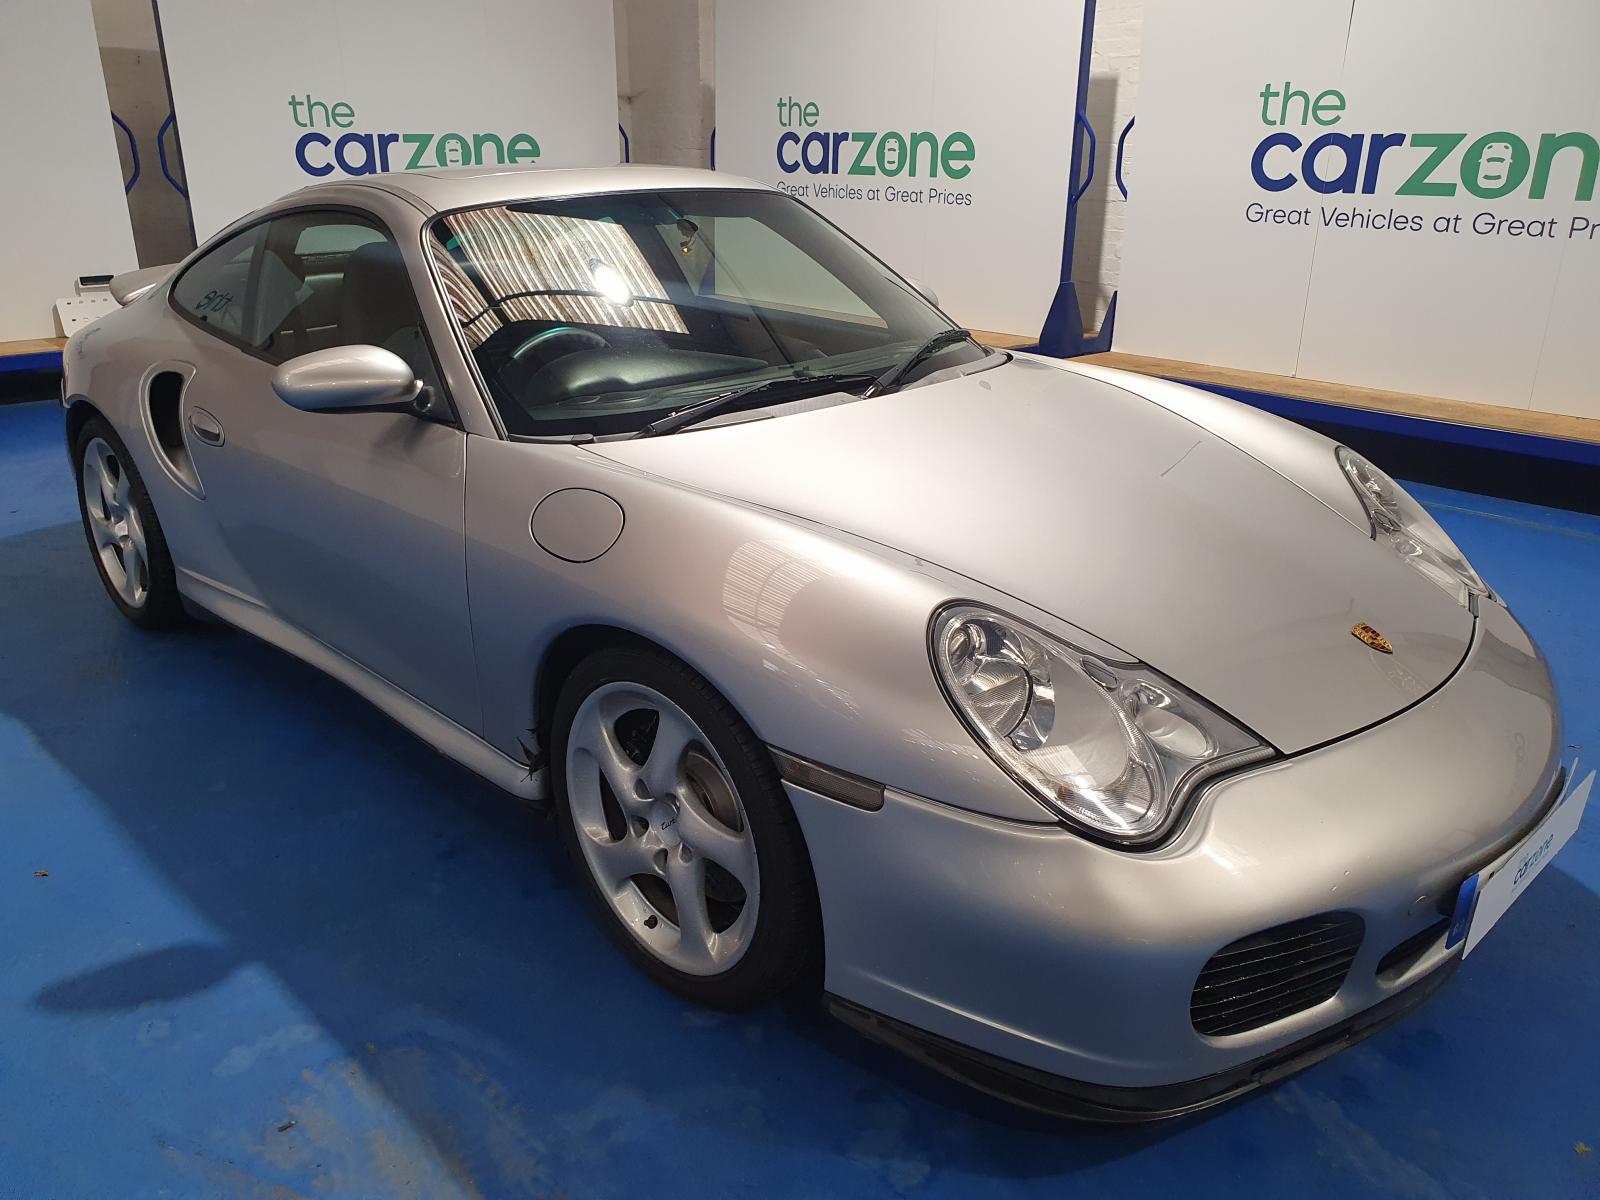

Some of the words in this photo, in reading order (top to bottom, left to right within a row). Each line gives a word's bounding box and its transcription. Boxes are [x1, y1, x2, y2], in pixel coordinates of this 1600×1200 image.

[288, 95, 355, 128] the
[777, 96, 820, 127] the
[1260, 82, 1346, 126] the
[295, 132, 541, 177] carzone
[777, 131, 976, 180] carzone
[813, 184, 863, 201] Vehicles
[867, 188, 880, 201] at
[884, 186, 923, 204] Great
[928, 188, 972, 206] Prices
[1245, 202, 1311, 227] Great
[1321, 206, 1423, 233] Vehicles
[1433, 213, 1462, 234] at
[1472, 212, 1557, 239] Great
